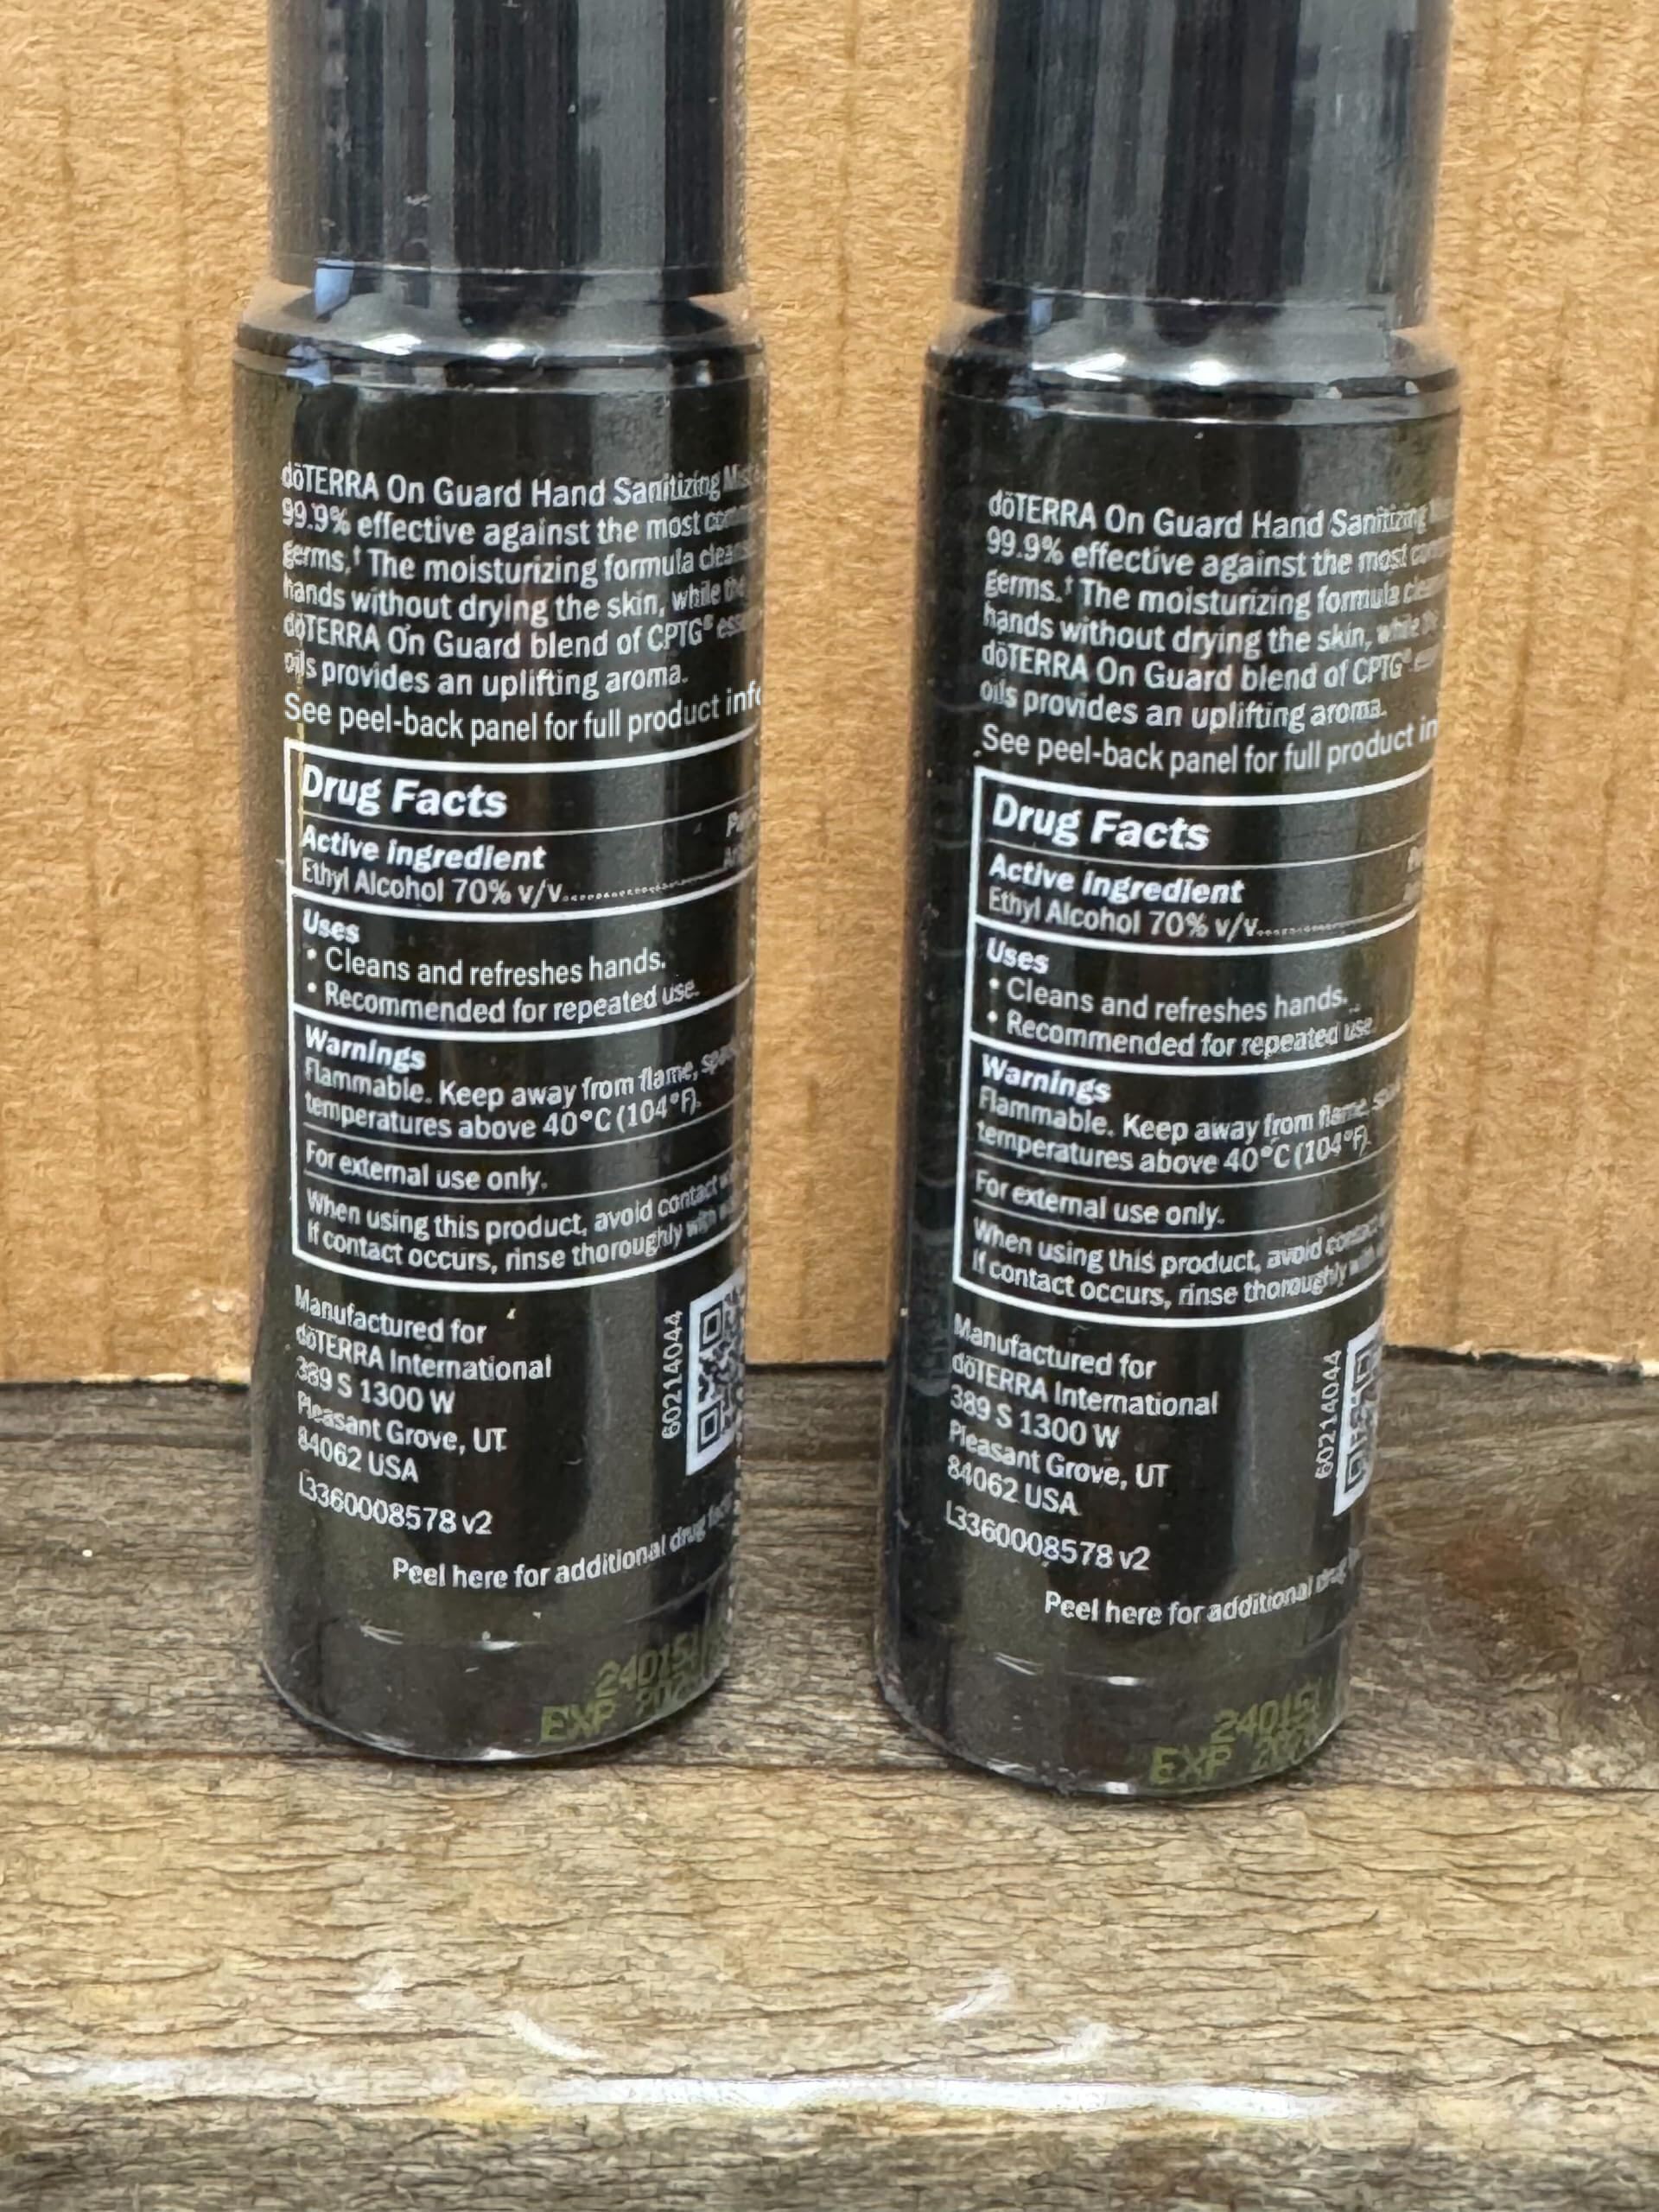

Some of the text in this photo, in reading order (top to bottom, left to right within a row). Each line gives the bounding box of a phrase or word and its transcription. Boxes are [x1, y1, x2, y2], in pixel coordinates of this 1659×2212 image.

[387, 474, 606, 507] On Guard Hand
[282, 498, 351, 536] 99.9%
[358, 510, 475, 544] effective
[483, 518, 590, 552] against
[596, 517, 639, 544] the
[647, 511, 701, 540] most
[1105, 504, 1324, 539] On Guard Hand
[366, 548, 415, 580] The
[424, 555, 598, 588] moisturizing
[604, 548, 694, 581] formula
[987, 525, 1353, 584] 99.9% effective against the
[283, 572, 665, 628] hands without drying the skin,
[1079, 577, 1130, 610] The
[1138, 586, 1311, 621] moisturizing
[1317, 581, 1400, 613] formula
[434, 626, 643, 659] Guard blend of
[983, 600, 1311, 660] hands without drying the
[322, 661, 688, 702] provides an uplifting aroma.
[1096, 656, 1318, 691] On Guard blend
[285, 691, 719, 747] See peel-back panel for full product
[1023, 690, 1306, 734] provides an uplifting
[982, 722, 1414, 779] See peel-back panel for full product
[302, 764, 506, 817] Drug Facts
[299, 821, 547, 873] Active ingredient
[993, 793, 1211, 850] Drug Facts
[302, 857, 512, 905] Ethyl Alcohol 70%
[988, 853, 1245, 904] Active ingredient
[303, 908, 359, 944] Uses
[989, 886, 1209, 938] Ethyl Alcohol 70%
[325, 947, 665, 987] Cleans and refreshes hands.
[987, 938, 1049, 974] Uses
[325, 980, 657, 1024] Recommended for repeated
[1007, 976, 1348, 1023] Cleans and refreshes hands.
[305, 1024, 425, 1077] Warnings
[1007, 1009, 1237, 1057] Recommended for
[304, 1057, 633, 1112] Flammable. Keep away from
[982, 1049, 1116, 1104] Warnings
[305, 1090, 536, 1140] temperatures above
[979, 1081, 1313, 1146] Flammable. Keep away from
[306, 1139, 547, 1196] For external use only.
[976, 1116, 1217, 1174] temperatures above
[307, 1188, 360, 1224] When
[366, 1210, 430, 1242] using
[434, 1214, 480, 1239] this
[594, 1198, 652, 1231] avoid
[976, 1169, 1224, 1230] For external use only.
[322, 1230, 565, 1274] contact occurs, rinse
[974, 1217, 1155, 1274] When using this
[989, 1261, 1238, 1310] contact occurs, rinse
[296, 1285, 487, 1347] Manufactured for
[391, 1348, 551, 1381] International
[952, 1313, 1157, 1380] Manufactured for
[297, 1387, 465, 1455] Pleasant Grove,
[360, 1379, 454, 1414] 1300 W
[1055, 1381, 1218, 1416] International
[949, 1416, 1171, 1491] Pleasant Grove, UT
[1020, 1410, 1087, 1446] 1300
[368, 1451, 418, 1483] USA
[299, 1465, 493, 1535] L3360008578 v2
[1025, 1483, 1081, 1516] USA
[946, 1497, 1150, 1570] L3360008578 v2
[393, 1535, 665, 1589] Peel here for additional
[1045, 1576, 1313, 1625] Peel here for additional
[540, 1698, 616, 1742] EXP
